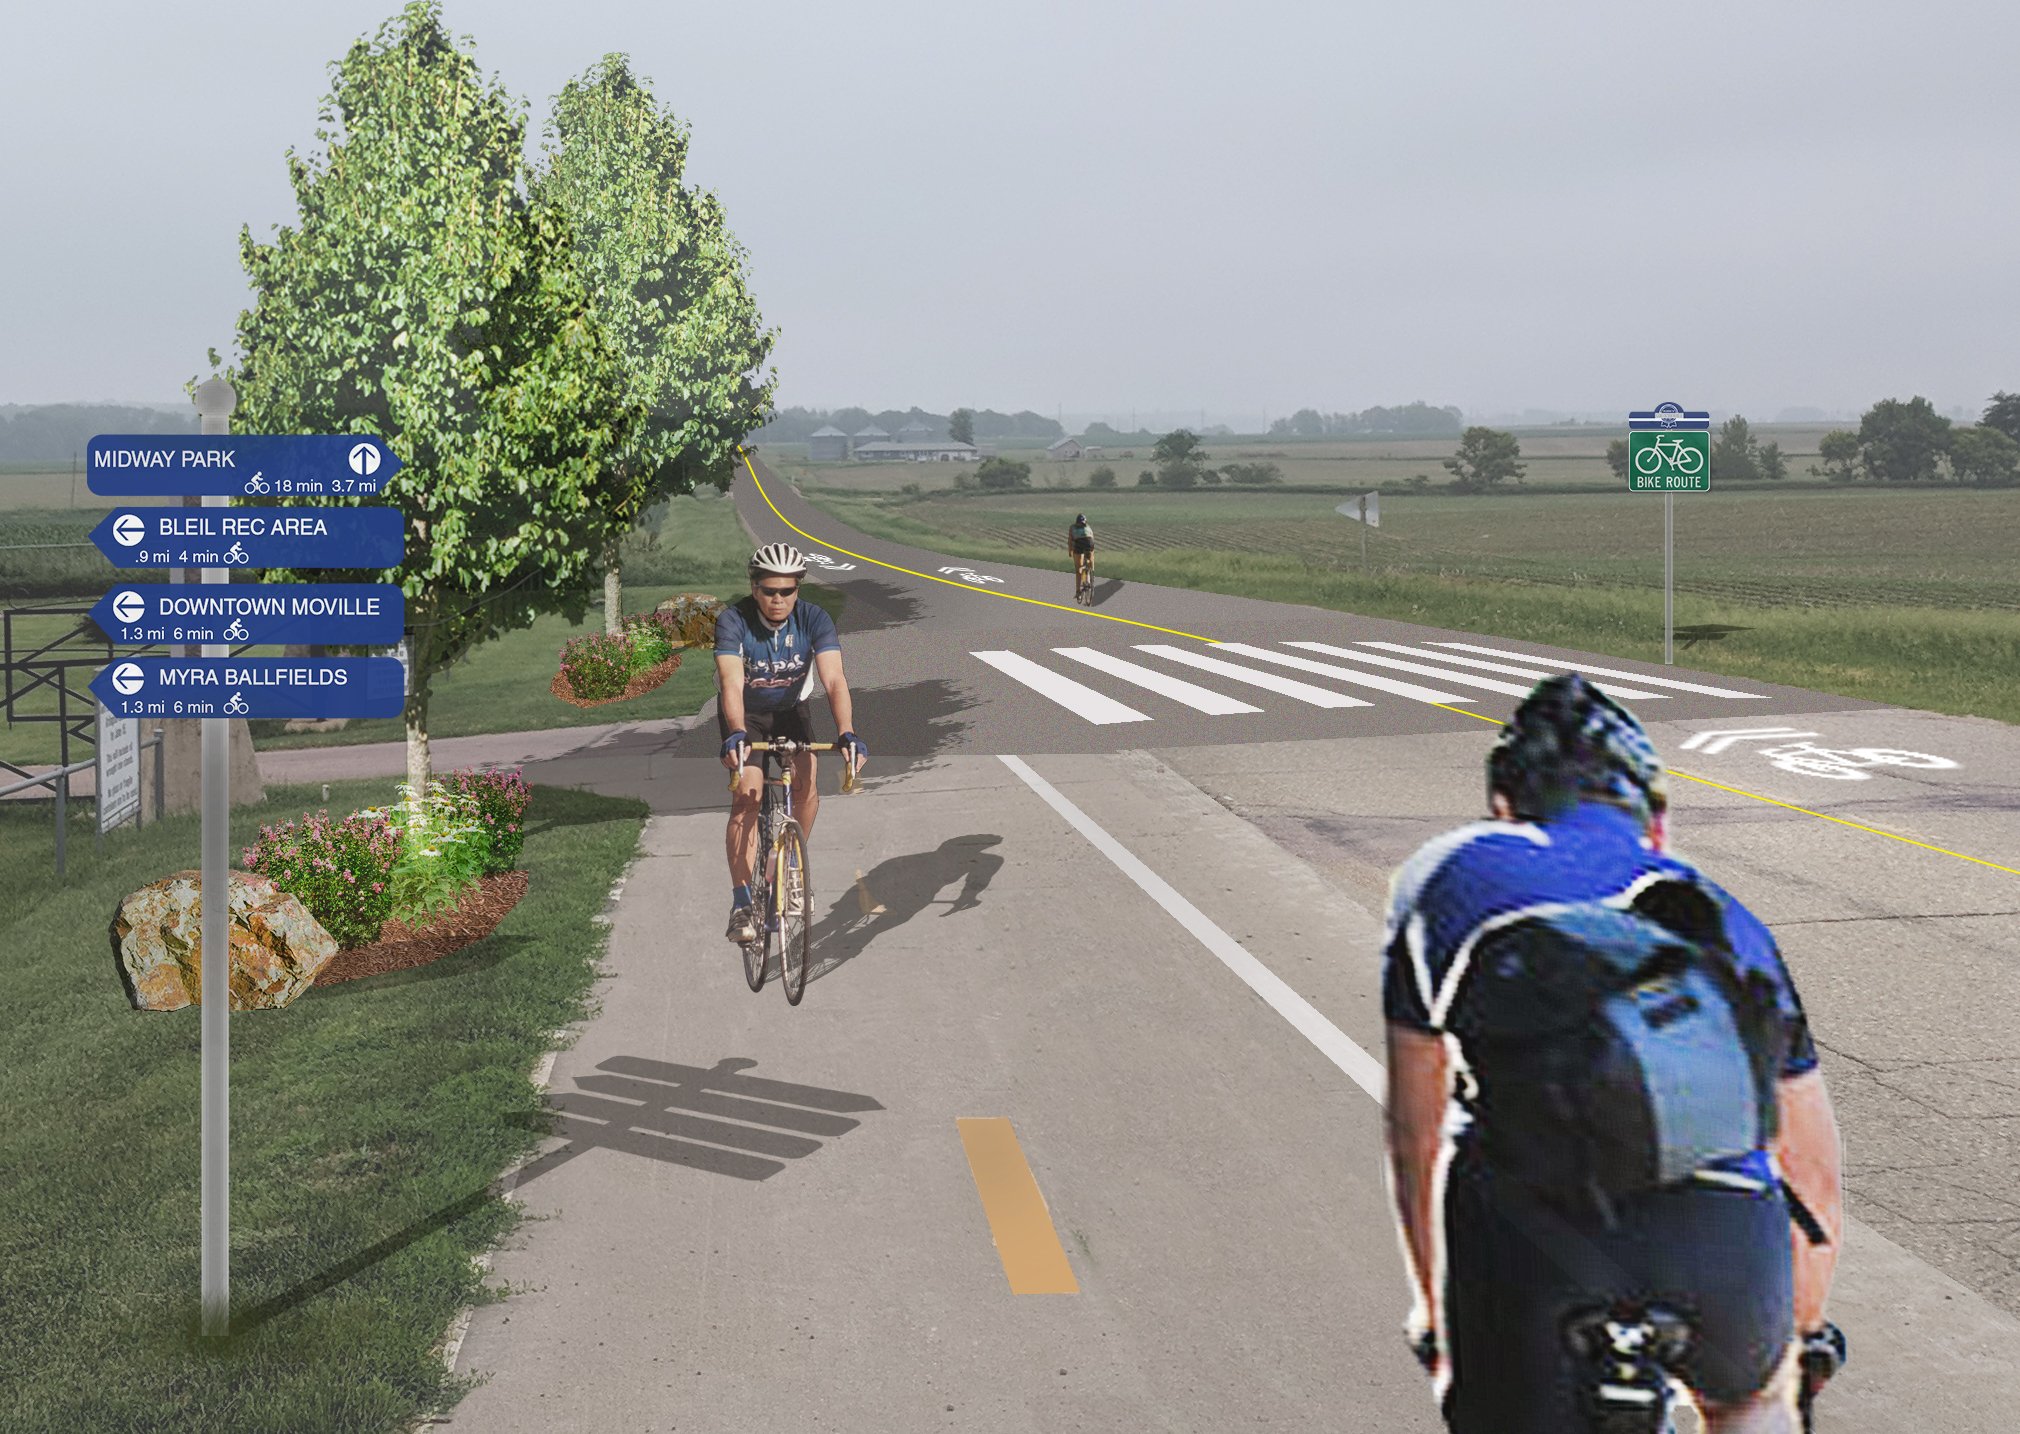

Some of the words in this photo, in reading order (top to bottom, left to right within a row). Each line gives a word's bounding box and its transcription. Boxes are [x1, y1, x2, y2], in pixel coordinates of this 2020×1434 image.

[94, 450, 175, 468] MIDWAY
[182, 450, 236, 468] PARK
[274, 479, 293, 492] 18
[296, 478, 323, 492] min
[331, 479, 355, 492] 3.7
[358, 478, 376, 492] mi
[1637, 476, 1661, 488] BIKE
[1666, 476, 1702, 488] ROUTE
[159, 518, 216, 536] BLEIL
[222, 518, 265, 536] REC
[270, 518, 328, 536] AREA
[135, 550, 149, 563] .9
[153, 549, 170, 563] mi
[178, 550, 189, 563] 4
[192, 549, 219, 563] min
[159, 597, 285, 616] DOWNTOWN
[292, 597, 380, 616] MOVILLE
[121, 627, 143, 640] 1.3
[147, 626, 165, 640] mi
[173, 627, 183, 640] 6
[187, 626, 214, 640] min
[159, 668, 219, 686] MYRA
[225, 668, 348, 686] BALLFIELDS
[121, 700, 144, 714] 1.3
[147, 700, 165, 714] mi
[173, 700, 183, 714] 6
[187, 700, 214, 714] min
